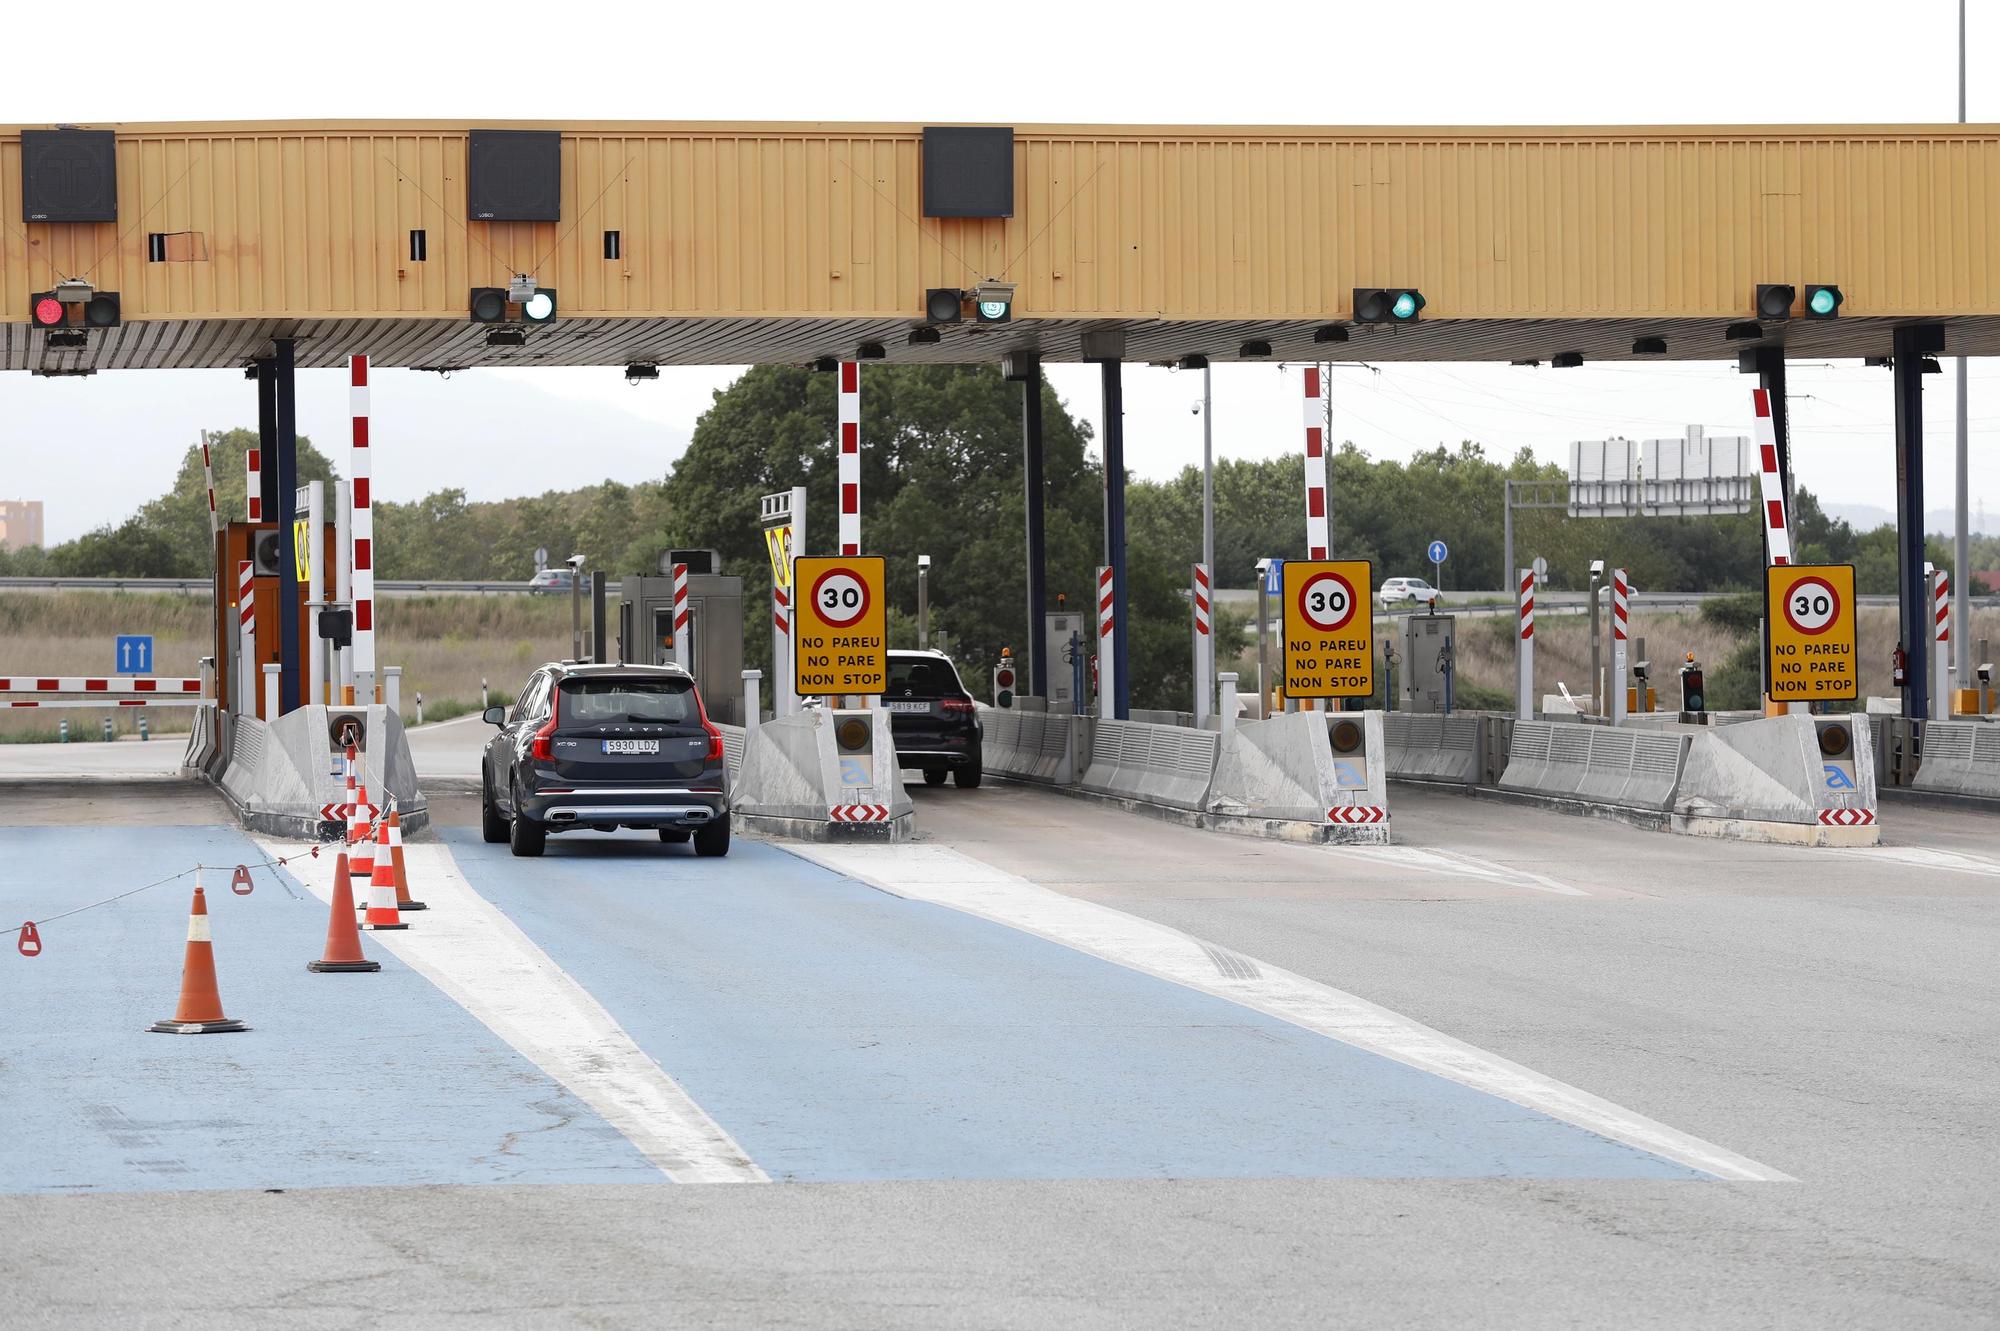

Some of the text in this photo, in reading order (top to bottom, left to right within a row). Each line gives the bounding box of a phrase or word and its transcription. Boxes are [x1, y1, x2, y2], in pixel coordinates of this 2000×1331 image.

[823, 588, 859, 608] 30
[1310, 591, 1345, 612] 30
[1795, 596, 1829, 616] 30
[802, 637, 880, 648] NO PAREU
[1290, 640, 1366, 651] NO PAREU
[1775, 644, 1850, 656] NO PAREU
[808, 655, 875, 666] NO PARE
[1296, 659, 1361, 669] NO PARE
[1781, 662, 1845, 673] NO PARE
[801, 674, 882, 685] NON STOP
[1290, 677, 1368, 688] NON STOP
[1775, 680, 1852, 691] NON STOP
[609, 740, 657, 751] 5930 LDZ
